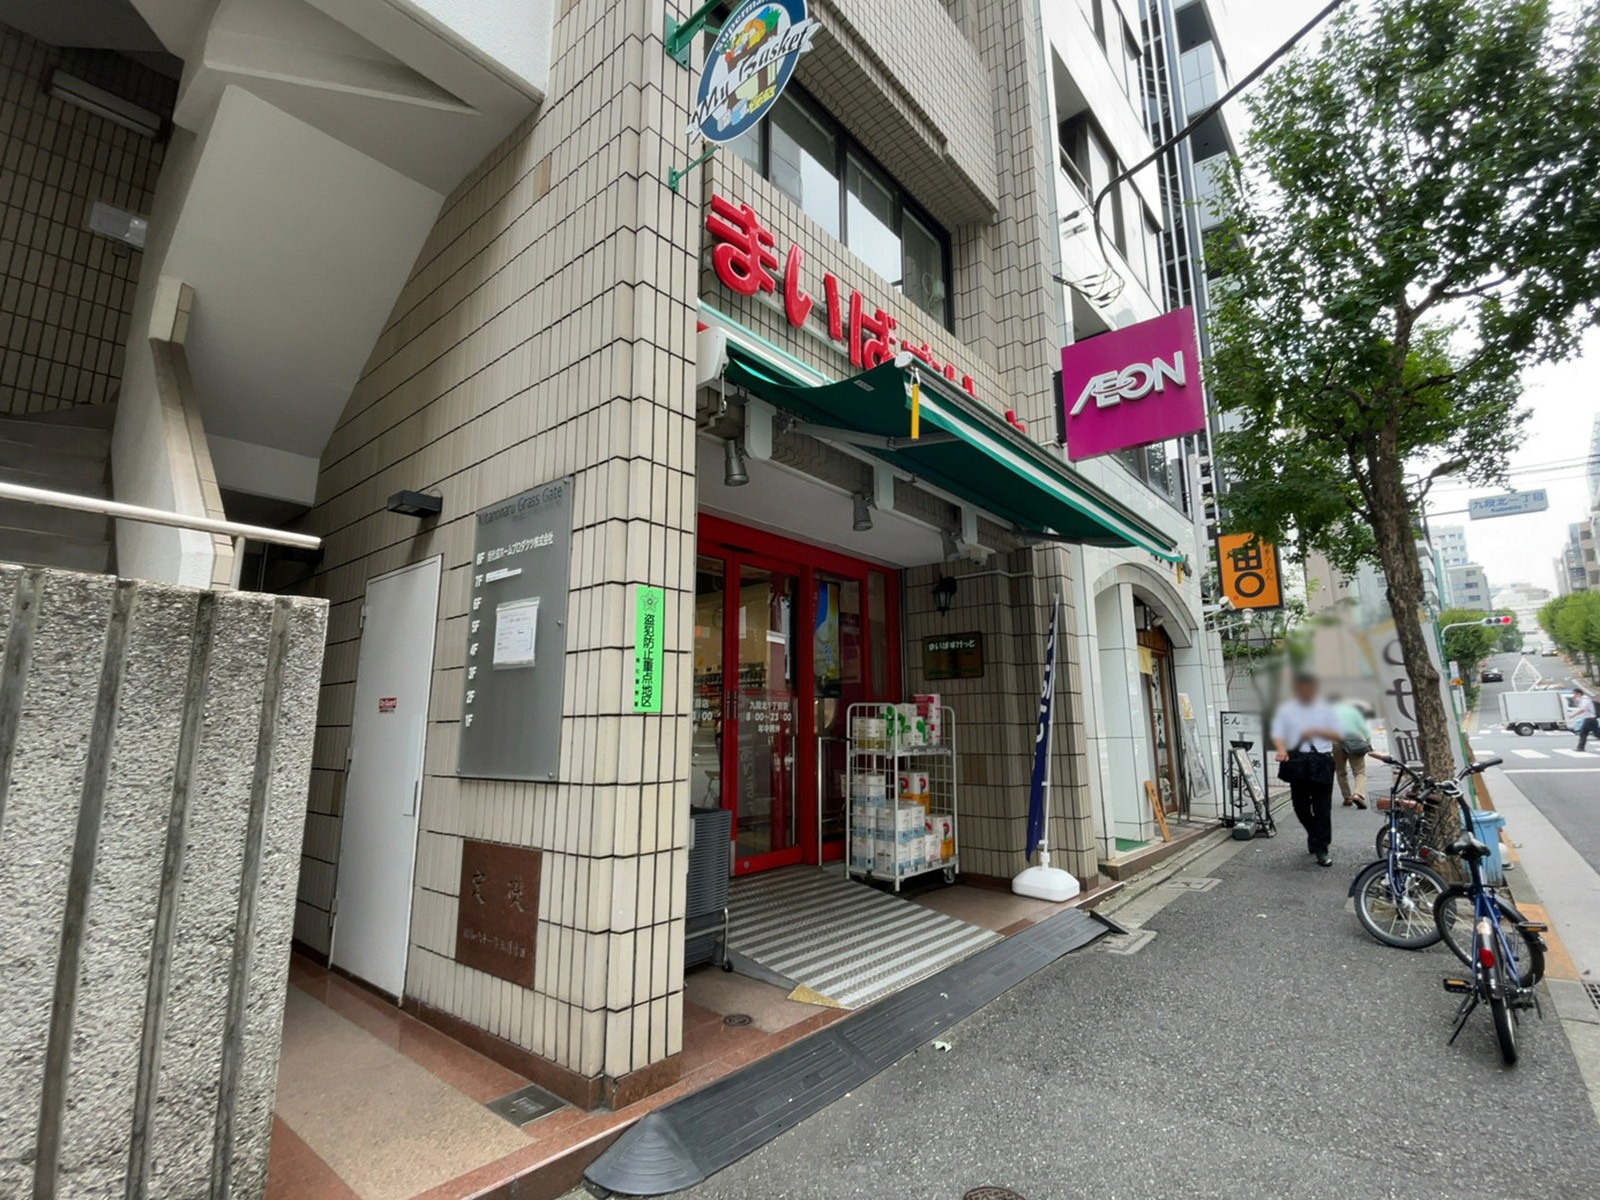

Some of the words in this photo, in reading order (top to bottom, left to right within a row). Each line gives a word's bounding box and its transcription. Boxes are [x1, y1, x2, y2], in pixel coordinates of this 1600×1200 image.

[691, 81, 730, 127] My
[739, 25, 809, 82] Basket
[1070, 350, 1186, 416] AEON
[517, 494, 540, 512] Grass
[542, 485, 563, 503] Gate
[1472, 492, 1545, 510] 九段北一丁目
[474, 574, 484, 588] 7F
[472, 596, 482, 611] 6F
[471, 619, 481, 634] 5F
[469, 642, 479, 657] 4F
[468, 666, 478, 680] 3F
[466, 690, 476, 704] 2F
[464, 713, 474, 728] 1F
